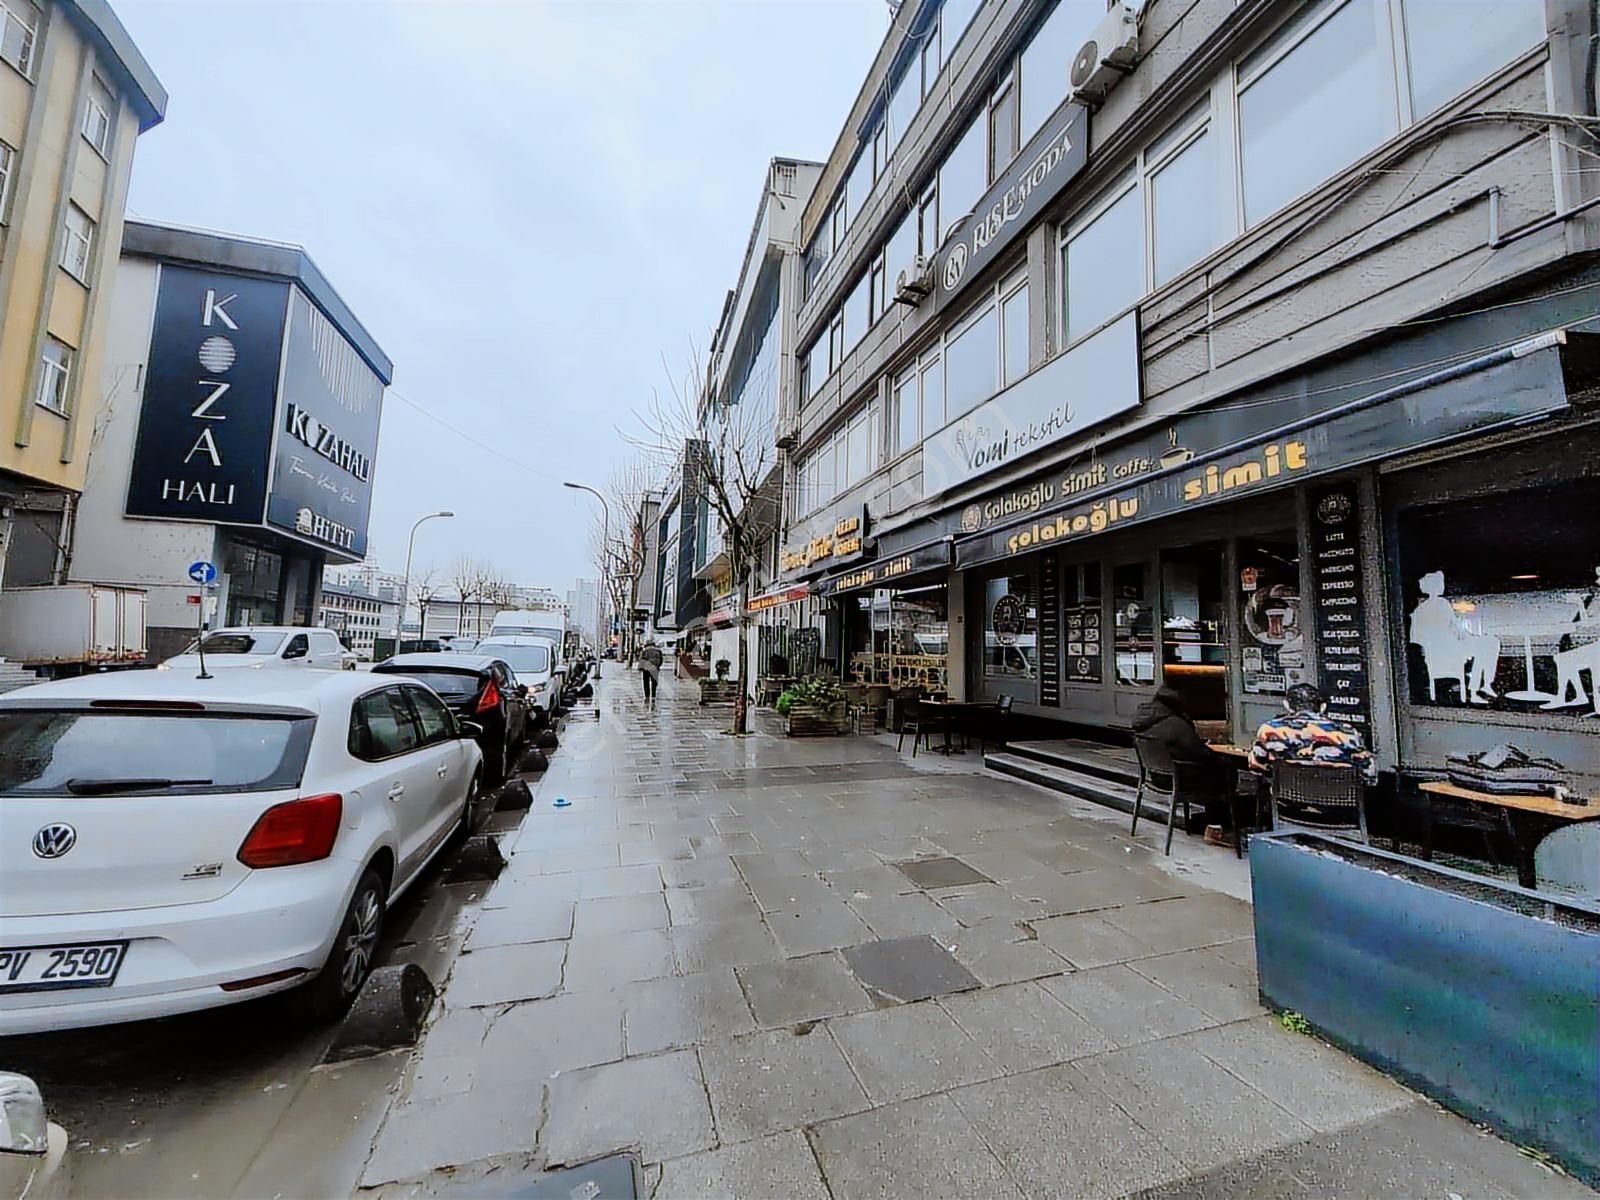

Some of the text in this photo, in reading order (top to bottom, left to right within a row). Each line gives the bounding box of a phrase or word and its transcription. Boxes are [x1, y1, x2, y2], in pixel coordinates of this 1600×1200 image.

[1013, 402, 1075, 452] tekstil
[162, 479, 235, 505] HALI
[984, 483, 1056, 526] Çolakoğlu
[1008, 498, 1138, 554] çolakoğlu
[1184, 441, 1307, 501] simit
[40, 947, 118, 980] 2590
